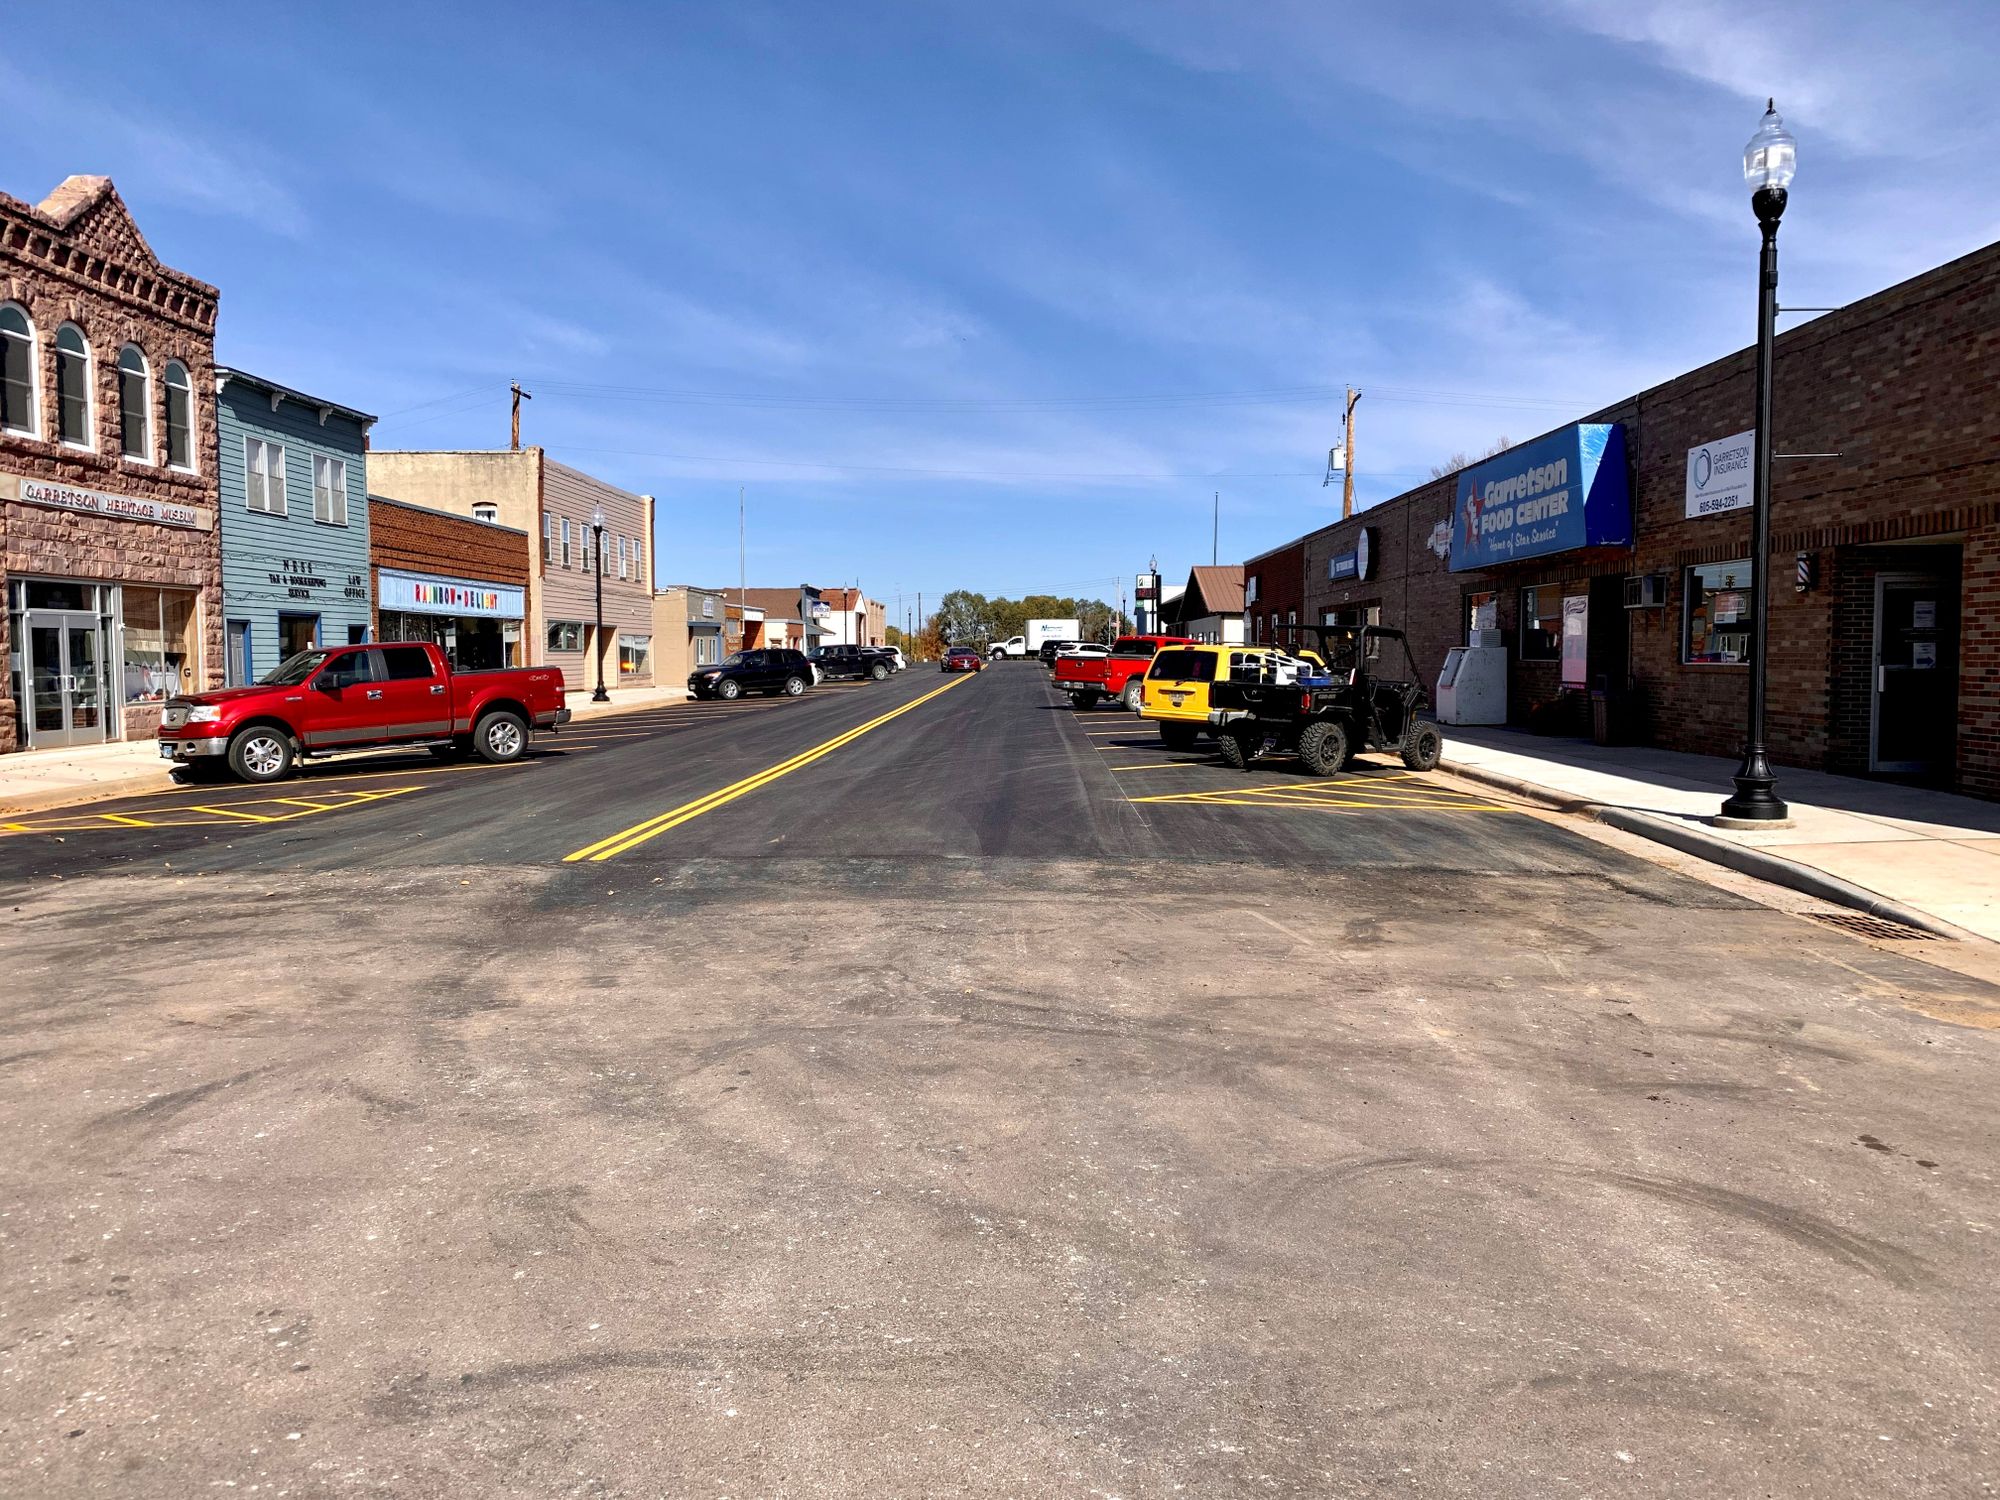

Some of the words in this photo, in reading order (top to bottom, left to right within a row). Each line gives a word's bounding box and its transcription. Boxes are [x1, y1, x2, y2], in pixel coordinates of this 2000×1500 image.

[1713, 446, 1750, 464] GARRETSON
[1714, 458, 1748, 475] INSURANCE
[1484, 458, 1568, 508] Garretson
[26, 484, 99, 511] GARRETSON
[105, 499, 154, 518] HERITAGE
[160, 508, 195, 524] MUSEUM
[1481, 507, 1513, 535] FOOD
[1516, 490, 1569, 525] CENTER
[1699, 495, 1739, 512] 605-594-2251
